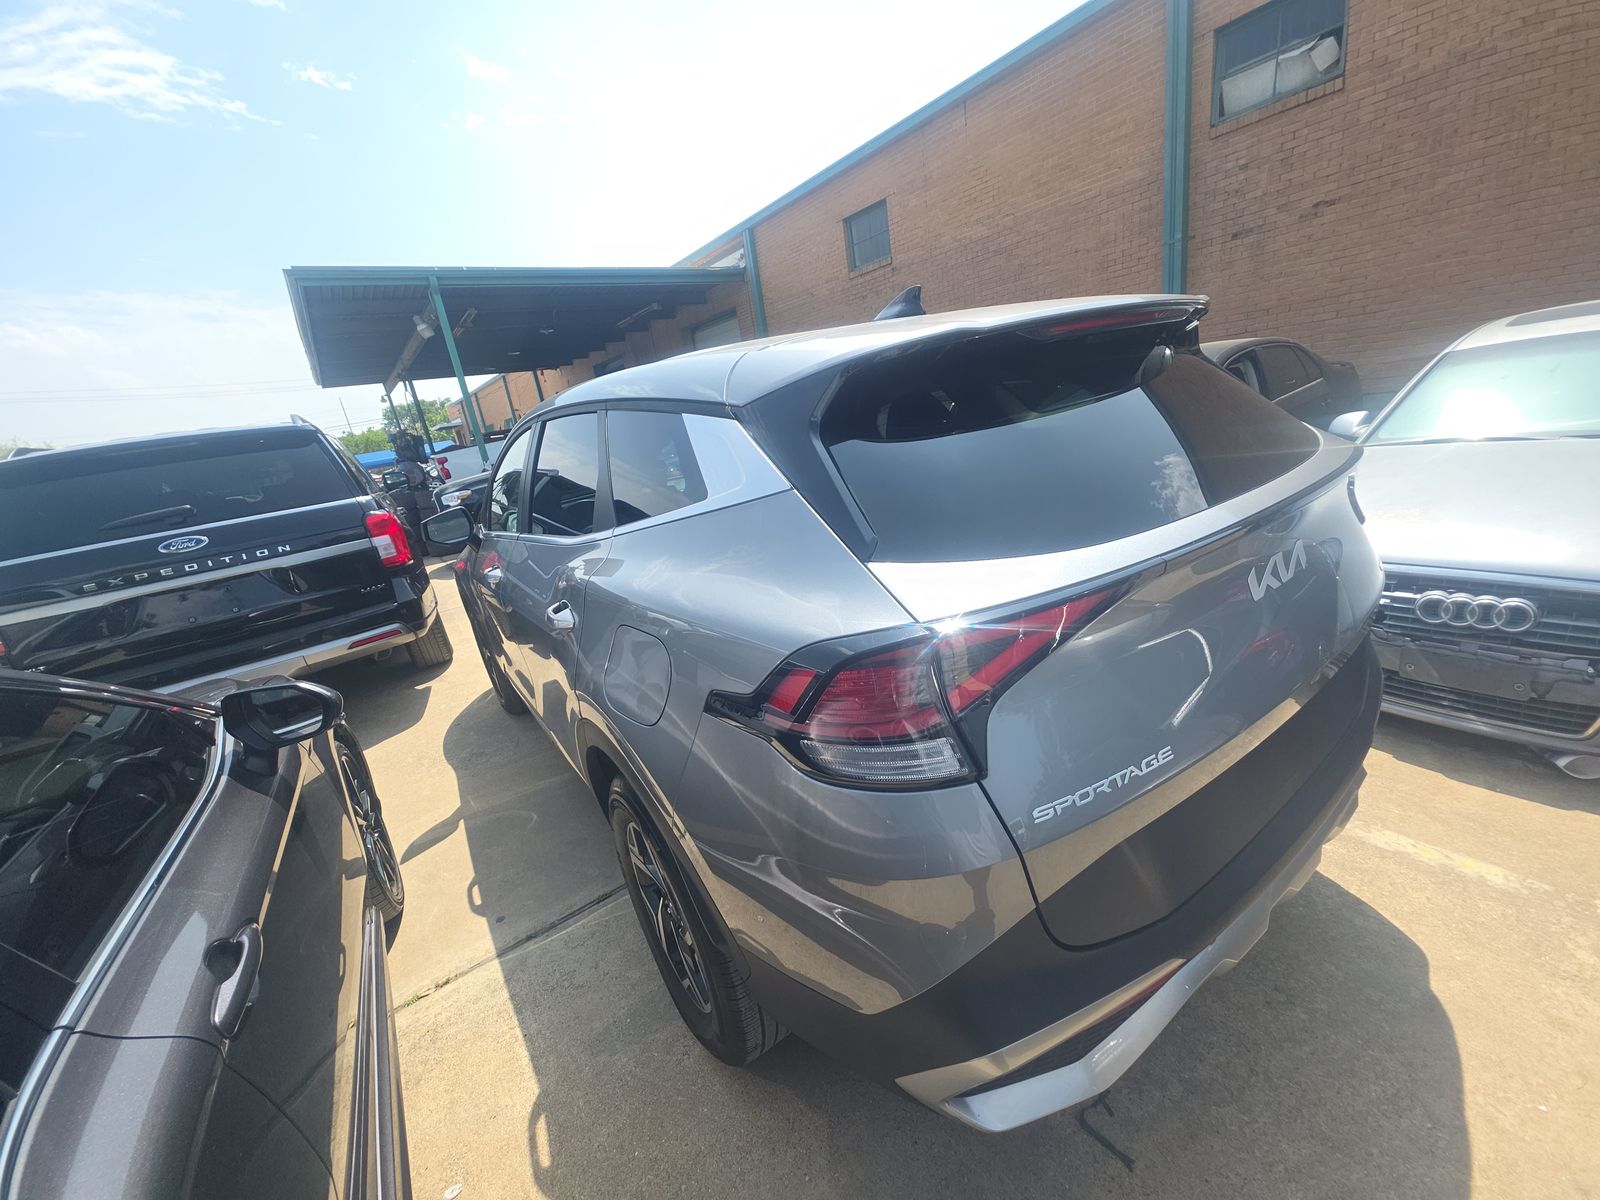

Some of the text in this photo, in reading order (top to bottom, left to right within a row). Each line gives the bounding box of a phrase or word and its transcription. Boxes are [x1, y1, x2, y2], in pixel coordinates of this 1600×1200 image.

[82, 544, 291, 593] EXPEDITION
[1247, 538, 1307, 602] KIA
[1031, 745, 1174, 825] SPORTAGE
